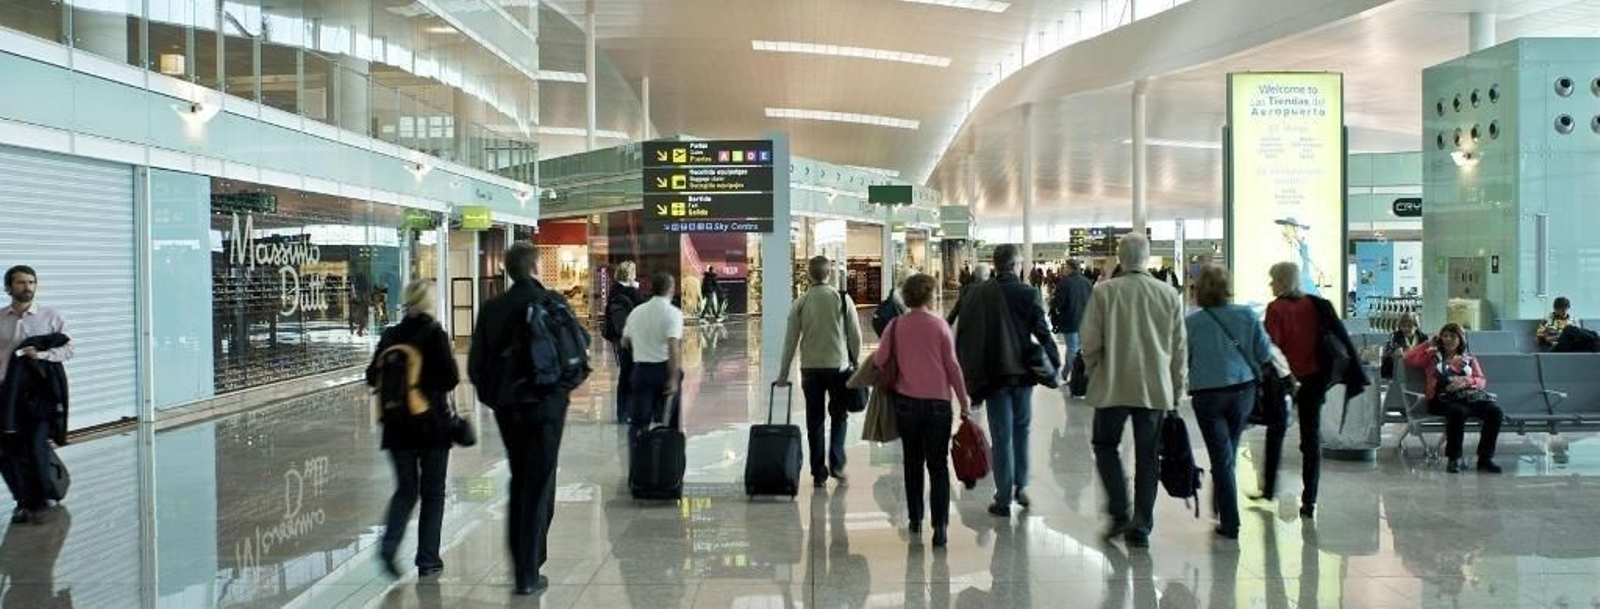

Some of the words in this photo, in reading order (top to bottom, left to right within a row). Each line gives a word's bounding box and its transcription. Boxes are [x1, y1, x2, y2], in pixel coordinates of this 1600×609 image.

[1259, 84, 1305, 94] Welcome
[1269, 97, 1309, 106] Tiendas
[1250, 108, 1326, 117] Aeropuerto
[714, 223, 729, 231] Sky
[230, 209, 321, 271] Massimo
[280, 265, 329, 316] Dutti
